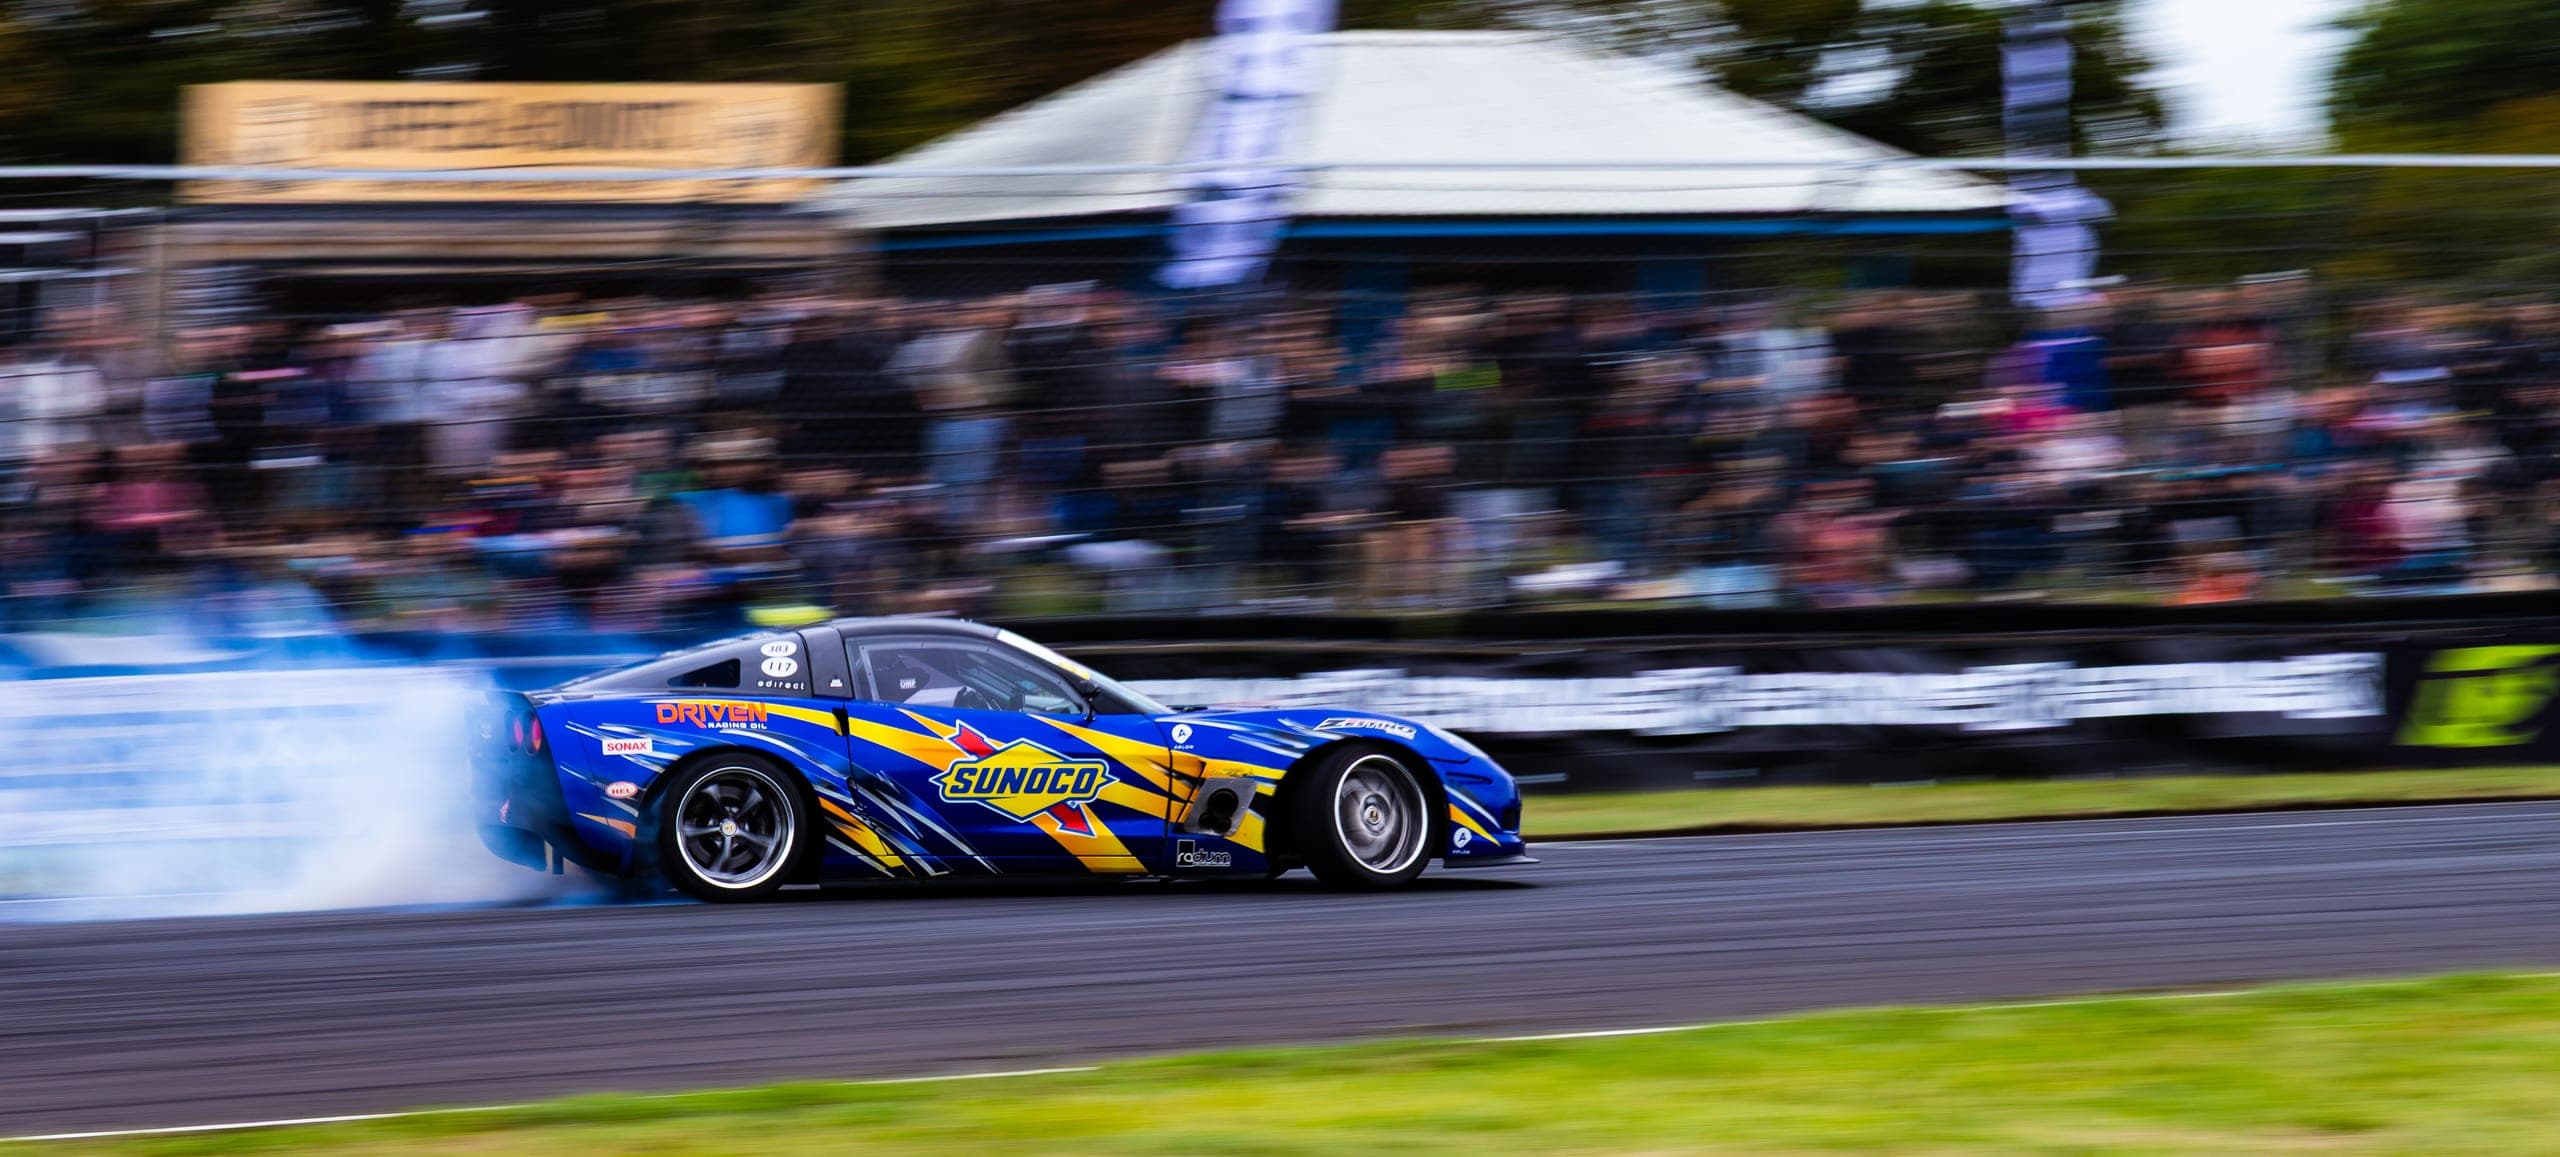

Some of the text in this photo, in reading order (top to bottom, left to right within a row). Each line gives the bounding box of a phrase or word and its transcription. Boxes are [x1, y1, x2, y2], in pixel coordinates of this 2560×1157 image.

[656, 702, 767, 729] DRIVEN
[607, 741, 647, 751] SONAX
[949, 767, 1099, 794] SUNOCO
